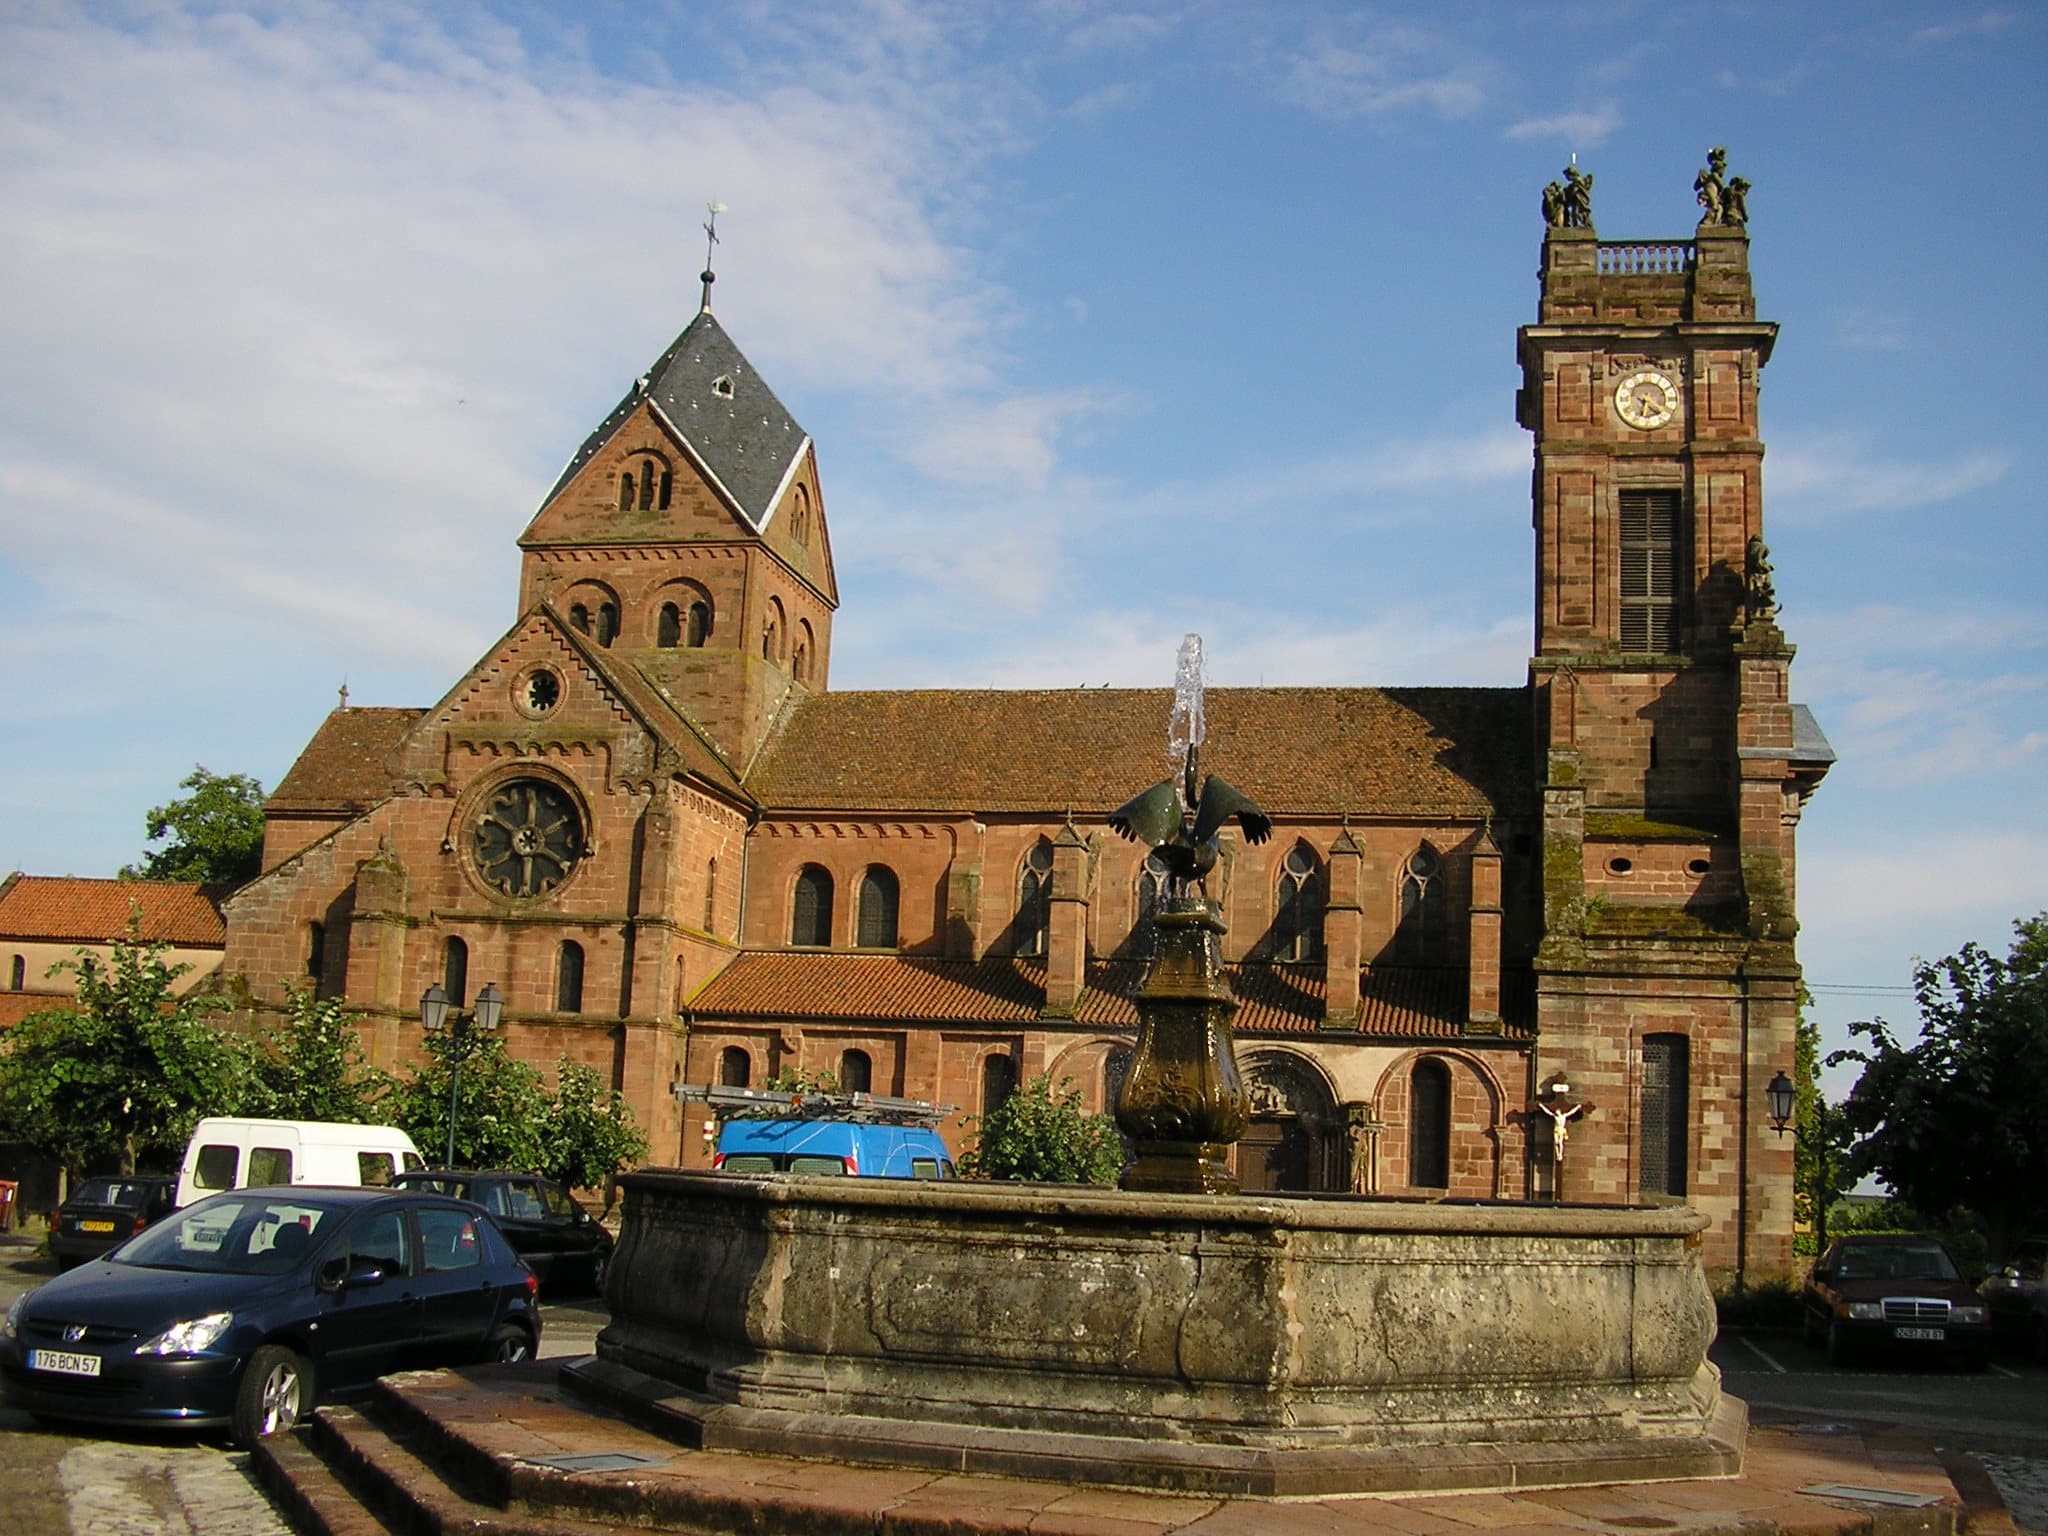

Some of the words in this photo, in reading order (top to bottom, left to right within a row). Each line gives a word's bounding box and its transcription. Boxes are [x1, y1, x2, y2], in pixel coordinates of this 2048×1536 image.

[37, 1351, 57, 1368] 176
[58, 1354, 81, 1371] BCN
[82, 1357, 98, 1372] 57
